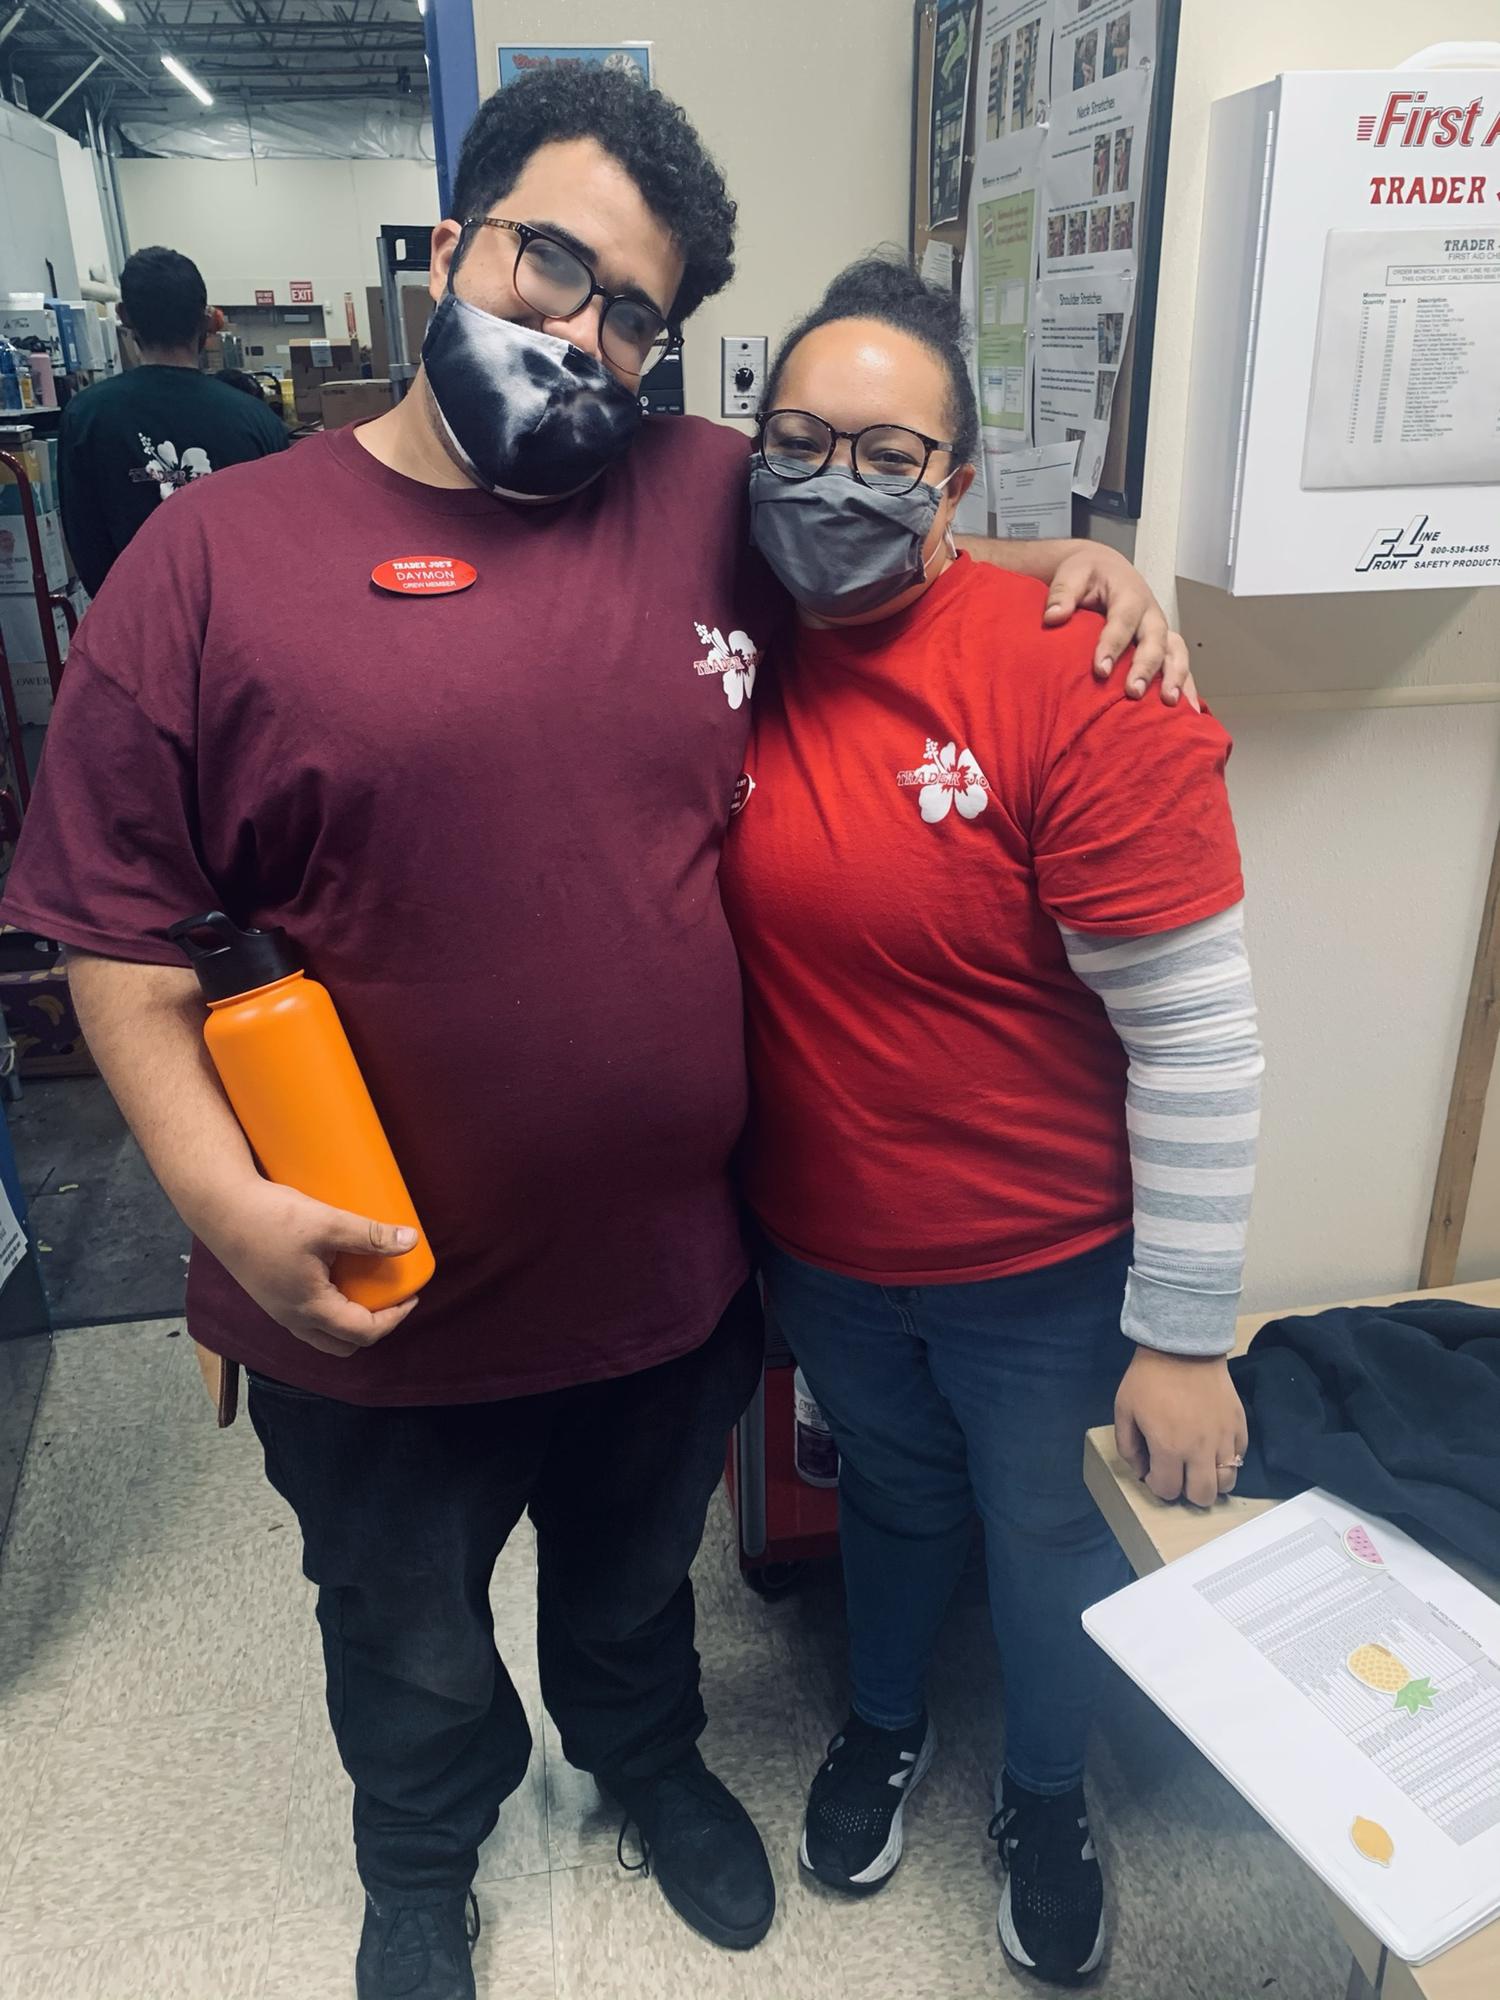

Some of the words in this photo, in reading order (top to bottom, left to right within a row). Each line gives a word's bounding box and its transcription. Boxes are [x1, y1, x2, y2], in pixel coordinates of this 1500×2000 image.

[1374, 91, 1483, 148] First
[1370, 176, 1486, 205] TRADER
[1444, 239, 1495, 252] TRADER
[1448, 252, 1470, 261] FIRST
[292, 290, 312, 301] EXIT
[1430, 545, 1490, 554] 800-538-4555
[392, 562, 427, 570] TRADER
[1414, 560, 1450, 569] SAFETY
[396, 570, 455, 581] DAYMON
[425, 580, 456, 588] MEMBER
